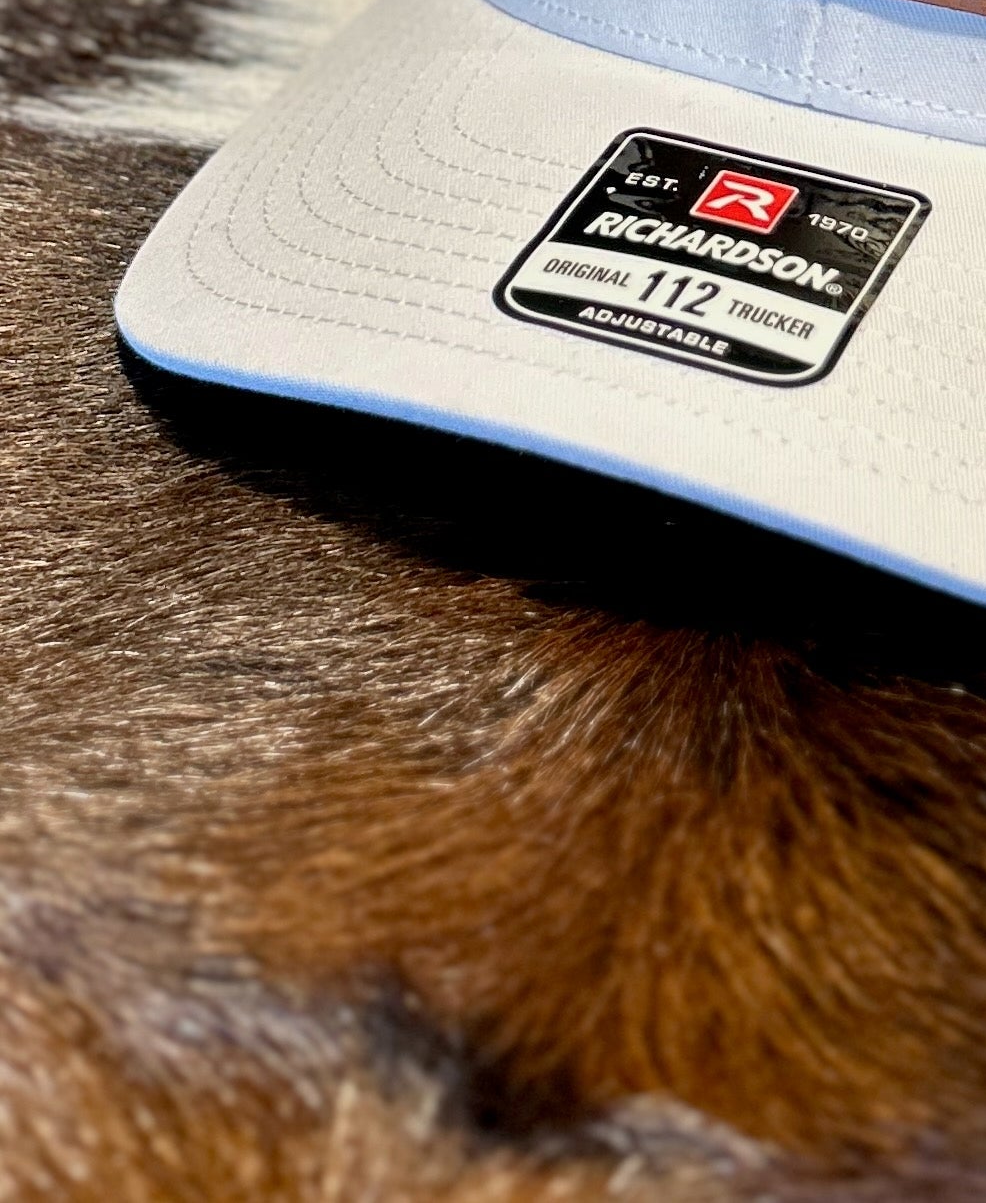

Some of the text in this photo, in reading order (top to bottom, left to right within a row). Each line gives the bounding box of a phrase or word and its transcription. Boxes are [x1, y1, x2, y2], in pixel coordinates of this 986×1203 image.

[624, 171, 679, 192] EST.
[807, 212, 869, 241] 1970
[542, 257, 815, 340] ORIGINAL 112 TRUCKER
[577, 304, 731, 356] ADJUSTABLE
